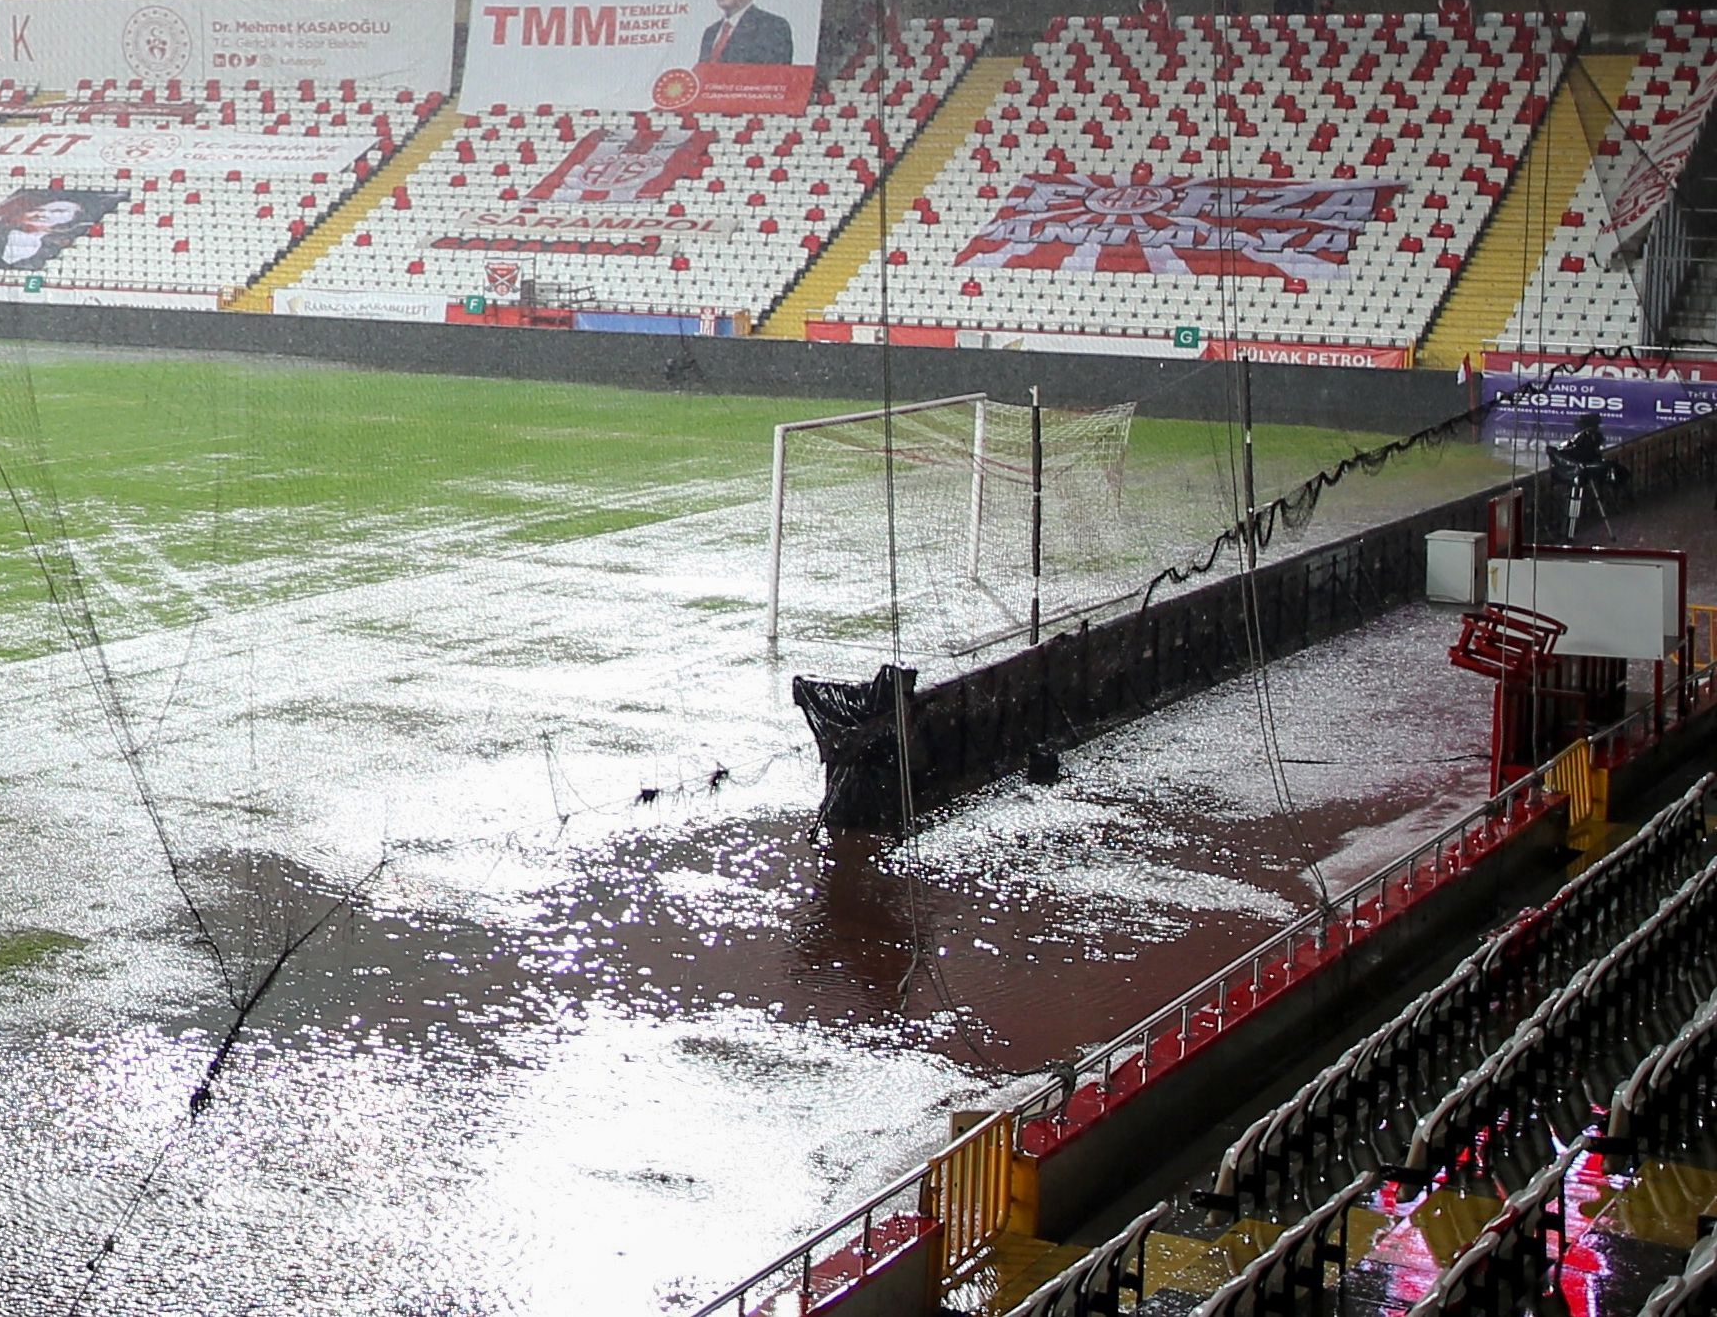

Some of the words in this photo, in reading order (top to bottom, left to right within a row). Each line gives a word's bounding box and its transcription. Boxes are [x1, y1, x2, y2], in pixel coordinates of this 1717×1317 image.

[619, 1, 690, 17] TEMİZLİK
[212, 21, 229, 33] Dr.
[236, 20, 293, 34] Mehmet
[297, 18, 391, 34] KASAPOĞLU
[483, 5, 618, 47] TMM
[619, 18, 671, 31] MASKE
[618, 32, 675, 46] MESAFE
[476, 211, 727, 234] SARAMPOL
[984, 220, 1350, 253] ANTALYA
[468, 298, 479, 311] F
[1179, 330, 1193, 344] G
[1306, 351, 1376, 367] PETROL
[1548, 384, 1577, 393] LAND
[1581, 385, 1595, 394] OF
[1496, 390, 1624, 411] LEGENDS
[1655, 399, 1717, 415] LEG
